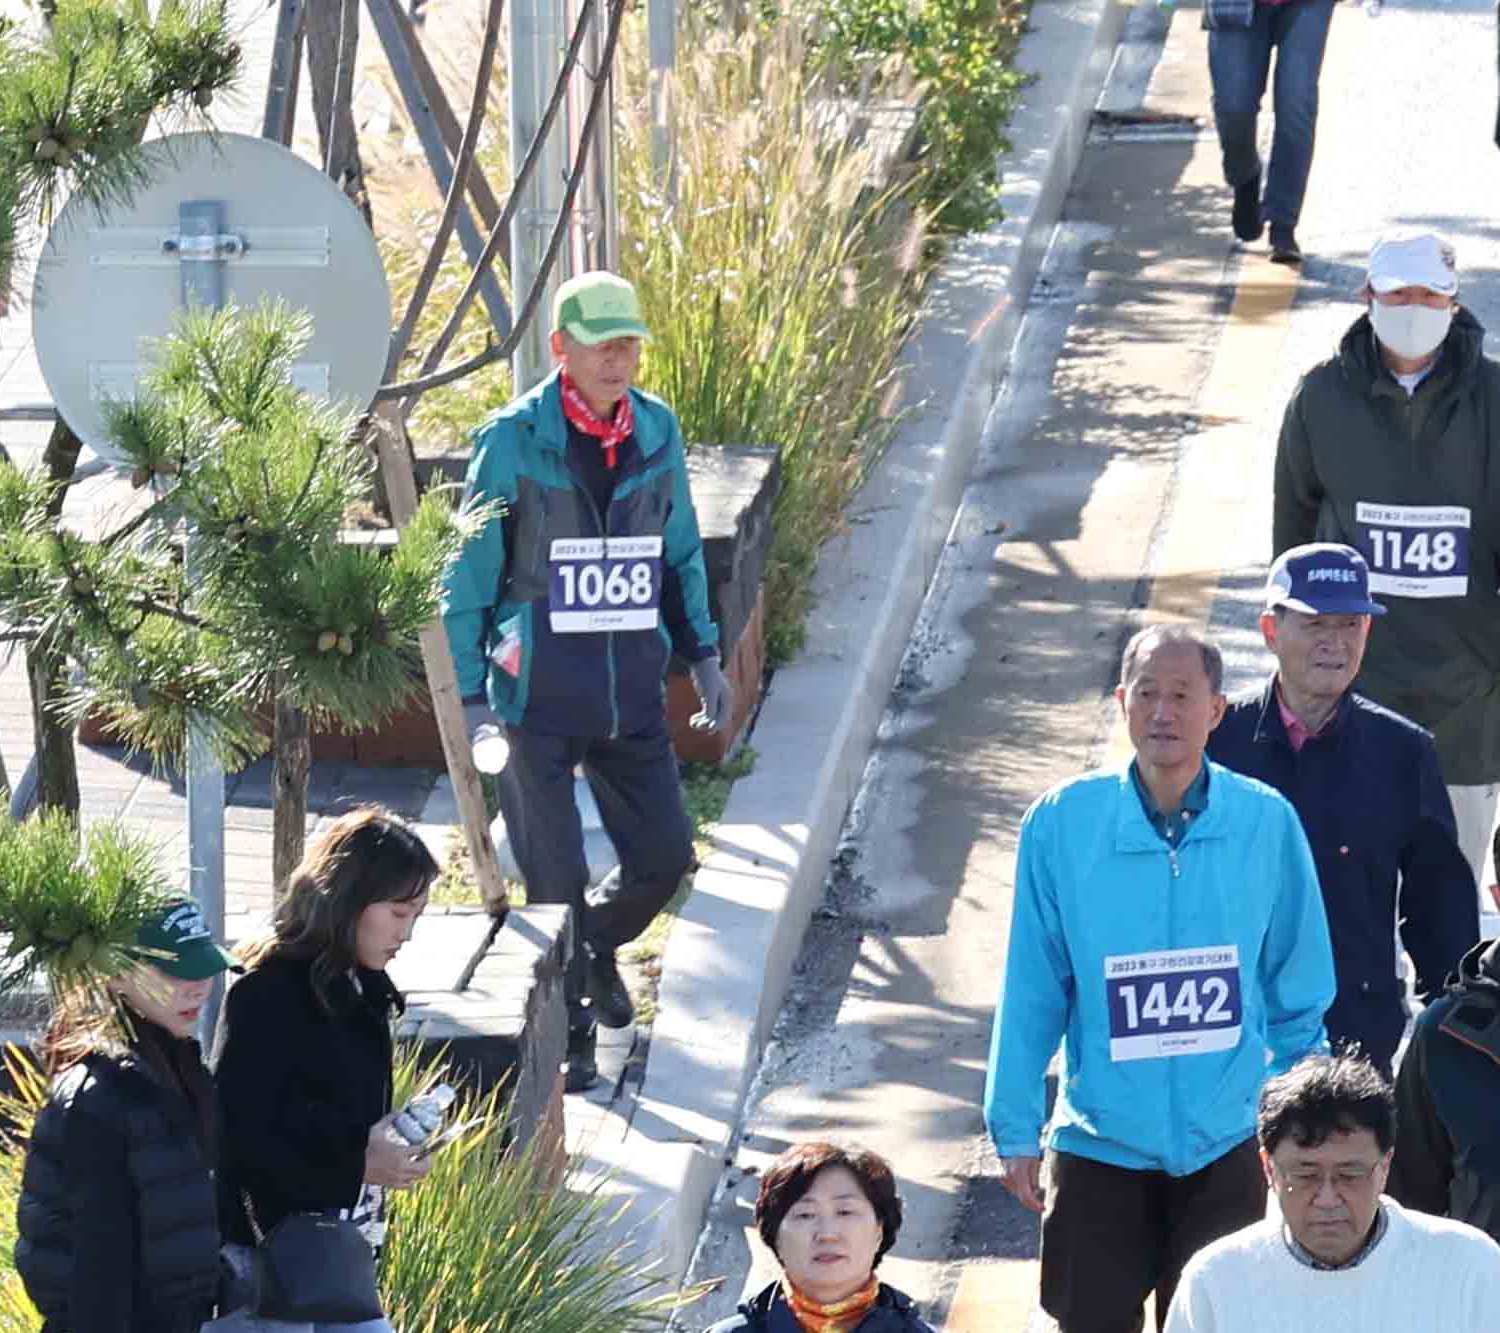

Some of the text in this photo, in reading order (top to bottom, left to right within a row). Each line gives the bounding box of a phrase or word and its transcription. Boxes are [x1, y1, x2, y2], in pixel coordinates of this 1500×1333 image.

[1368, 529, 1457, 572] 1148
[558, 562, 653, 606] 1068
[1110, 960, 1137, 973] 2023
[1118, 976, 1233, 1029] 1442
